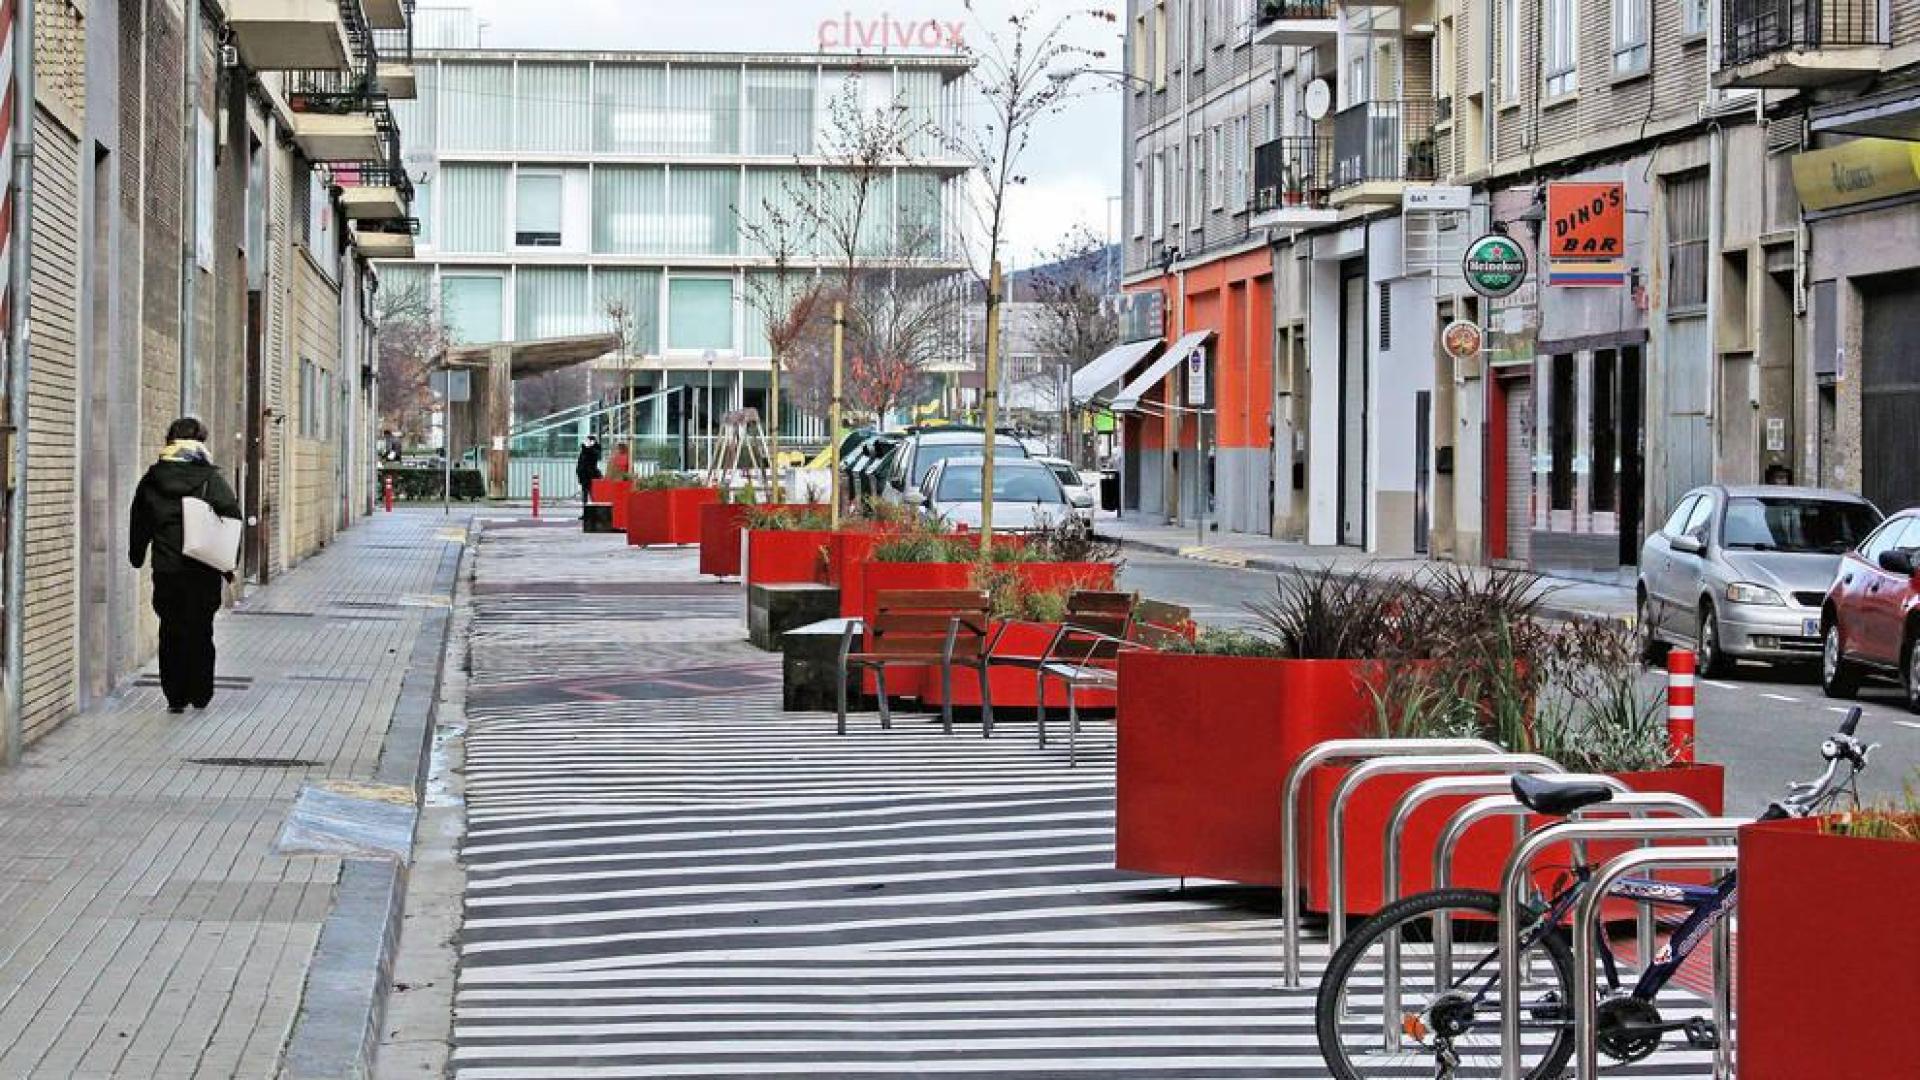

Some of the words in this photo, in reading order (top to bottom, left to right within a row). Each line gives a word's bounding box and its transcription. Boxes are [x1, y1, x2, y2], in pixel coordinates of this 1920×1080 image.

[818, 12, 965, 48] civivox
[1555, 187, 1620, 237] DINO'S
[1563, 237, 1618, 252] BAR
[1470, 260, 1521, 272] Heineken
